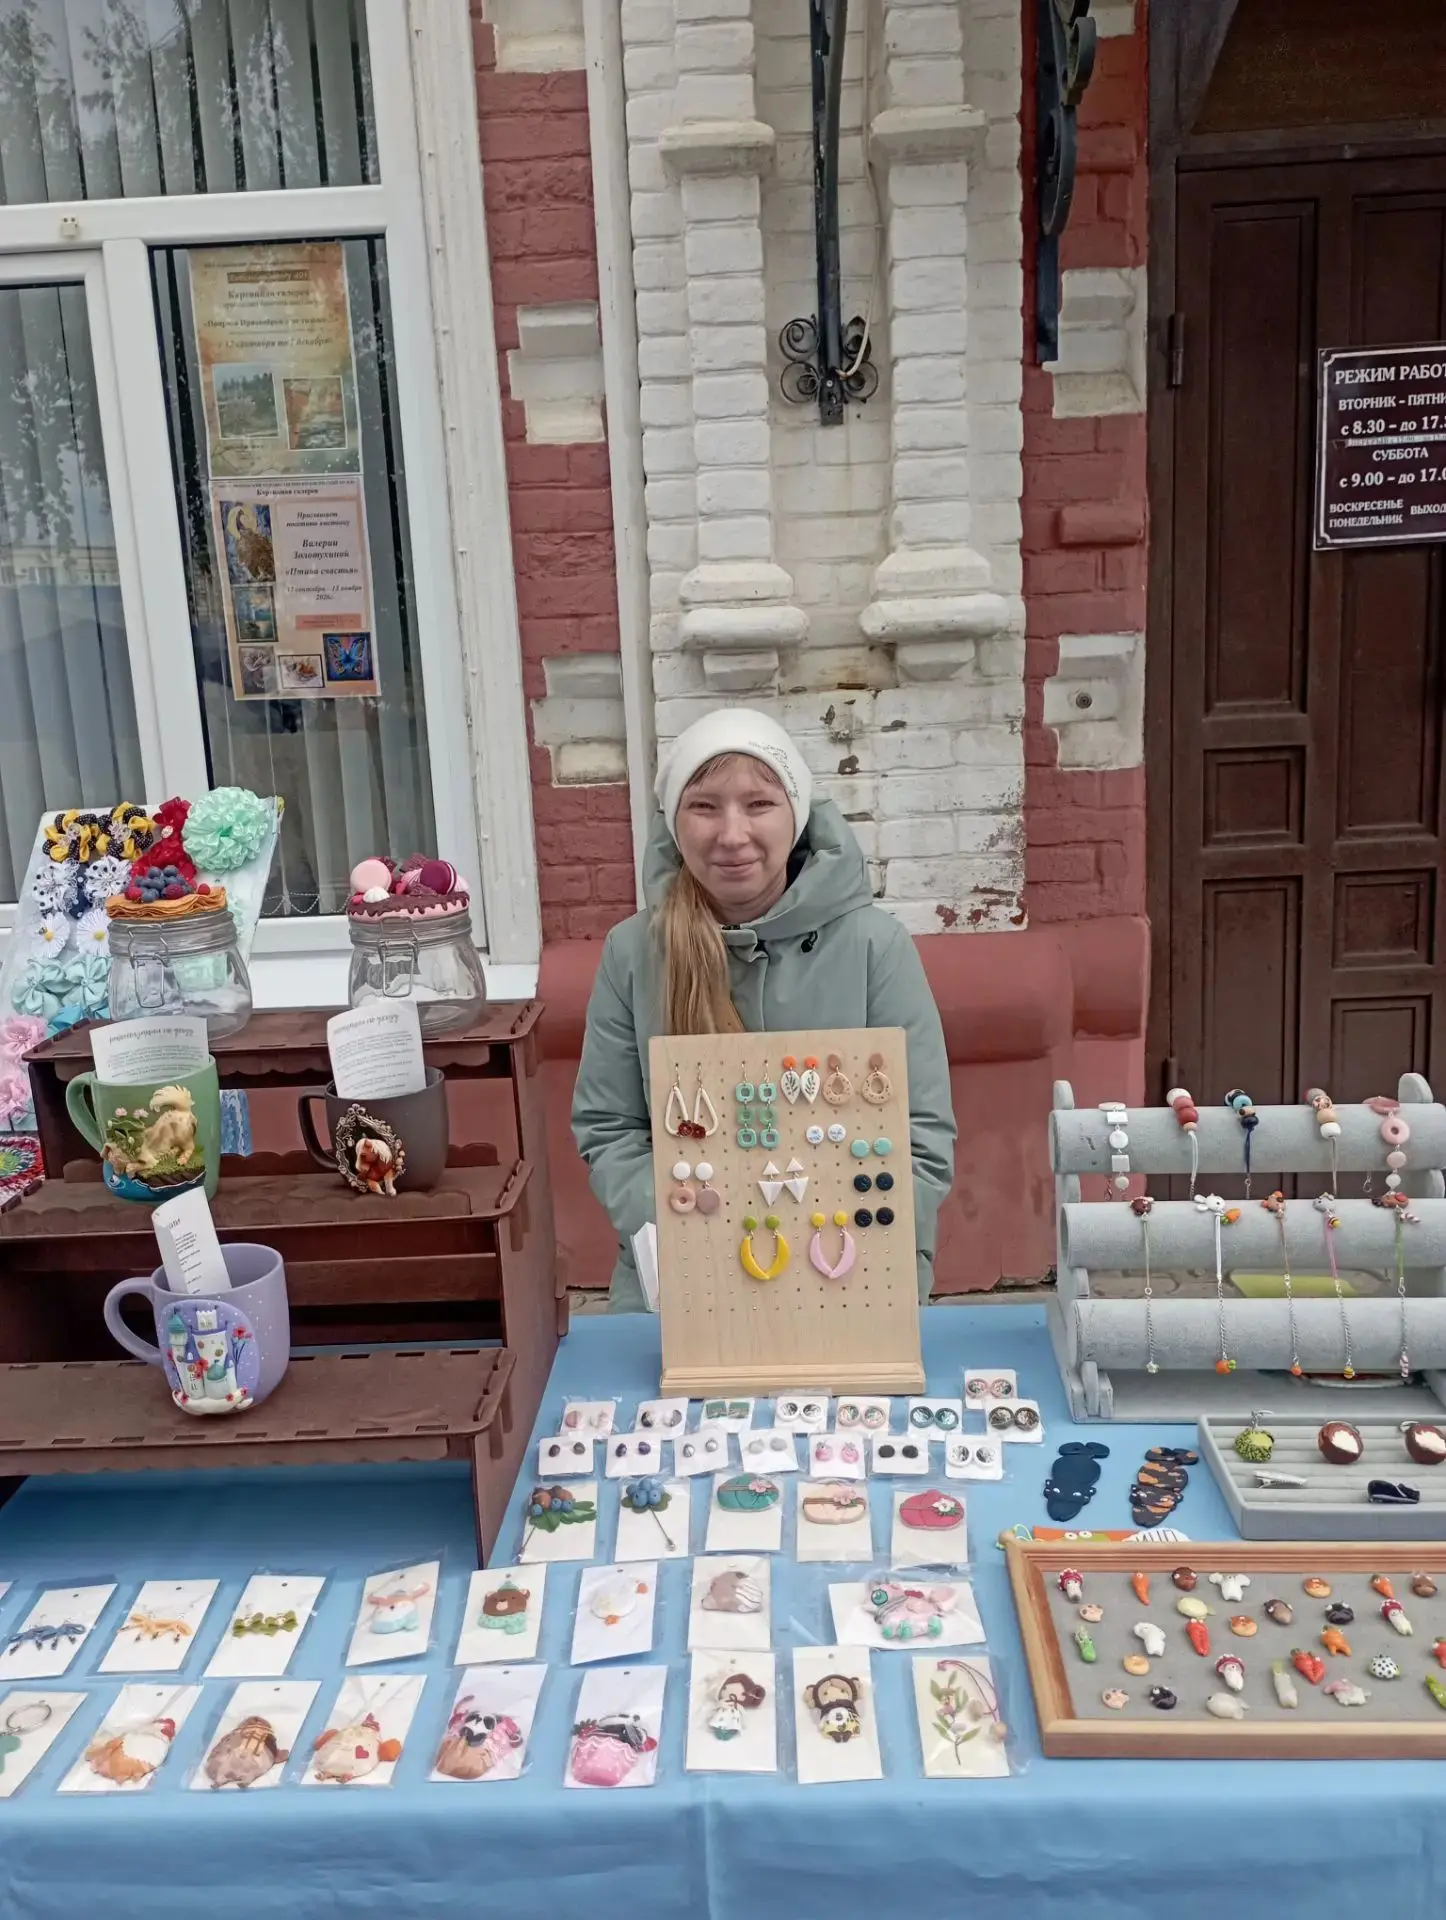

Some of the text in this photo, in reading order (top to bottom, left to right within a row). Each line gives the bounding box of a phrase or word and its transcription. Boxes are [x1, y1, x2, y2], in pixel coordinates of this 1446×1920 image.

[1335, 366, 1396, 384] РЕЖИМ
[1338, 396, 1397, 411] ВТОРНИК
[1341, 425, 1350, 436] с
[1352, 418, 1386, 435] 8.30
[1399, 420, 1417, 432] до
[1421, 415, 1446, 431] 17.
[1372, 446, 1429, 462] СУББОТА
[1339, 478, 1348, 488] с
[1351, 471, 1384, 488] 9.00
[1398, 472, 1416, 485] до
[1329, 499, 1404, 514] ВОСКРЕСЕНЬЕ
[1329, 514, 1404, 529] ПОНЕДЕЛЬНИК
